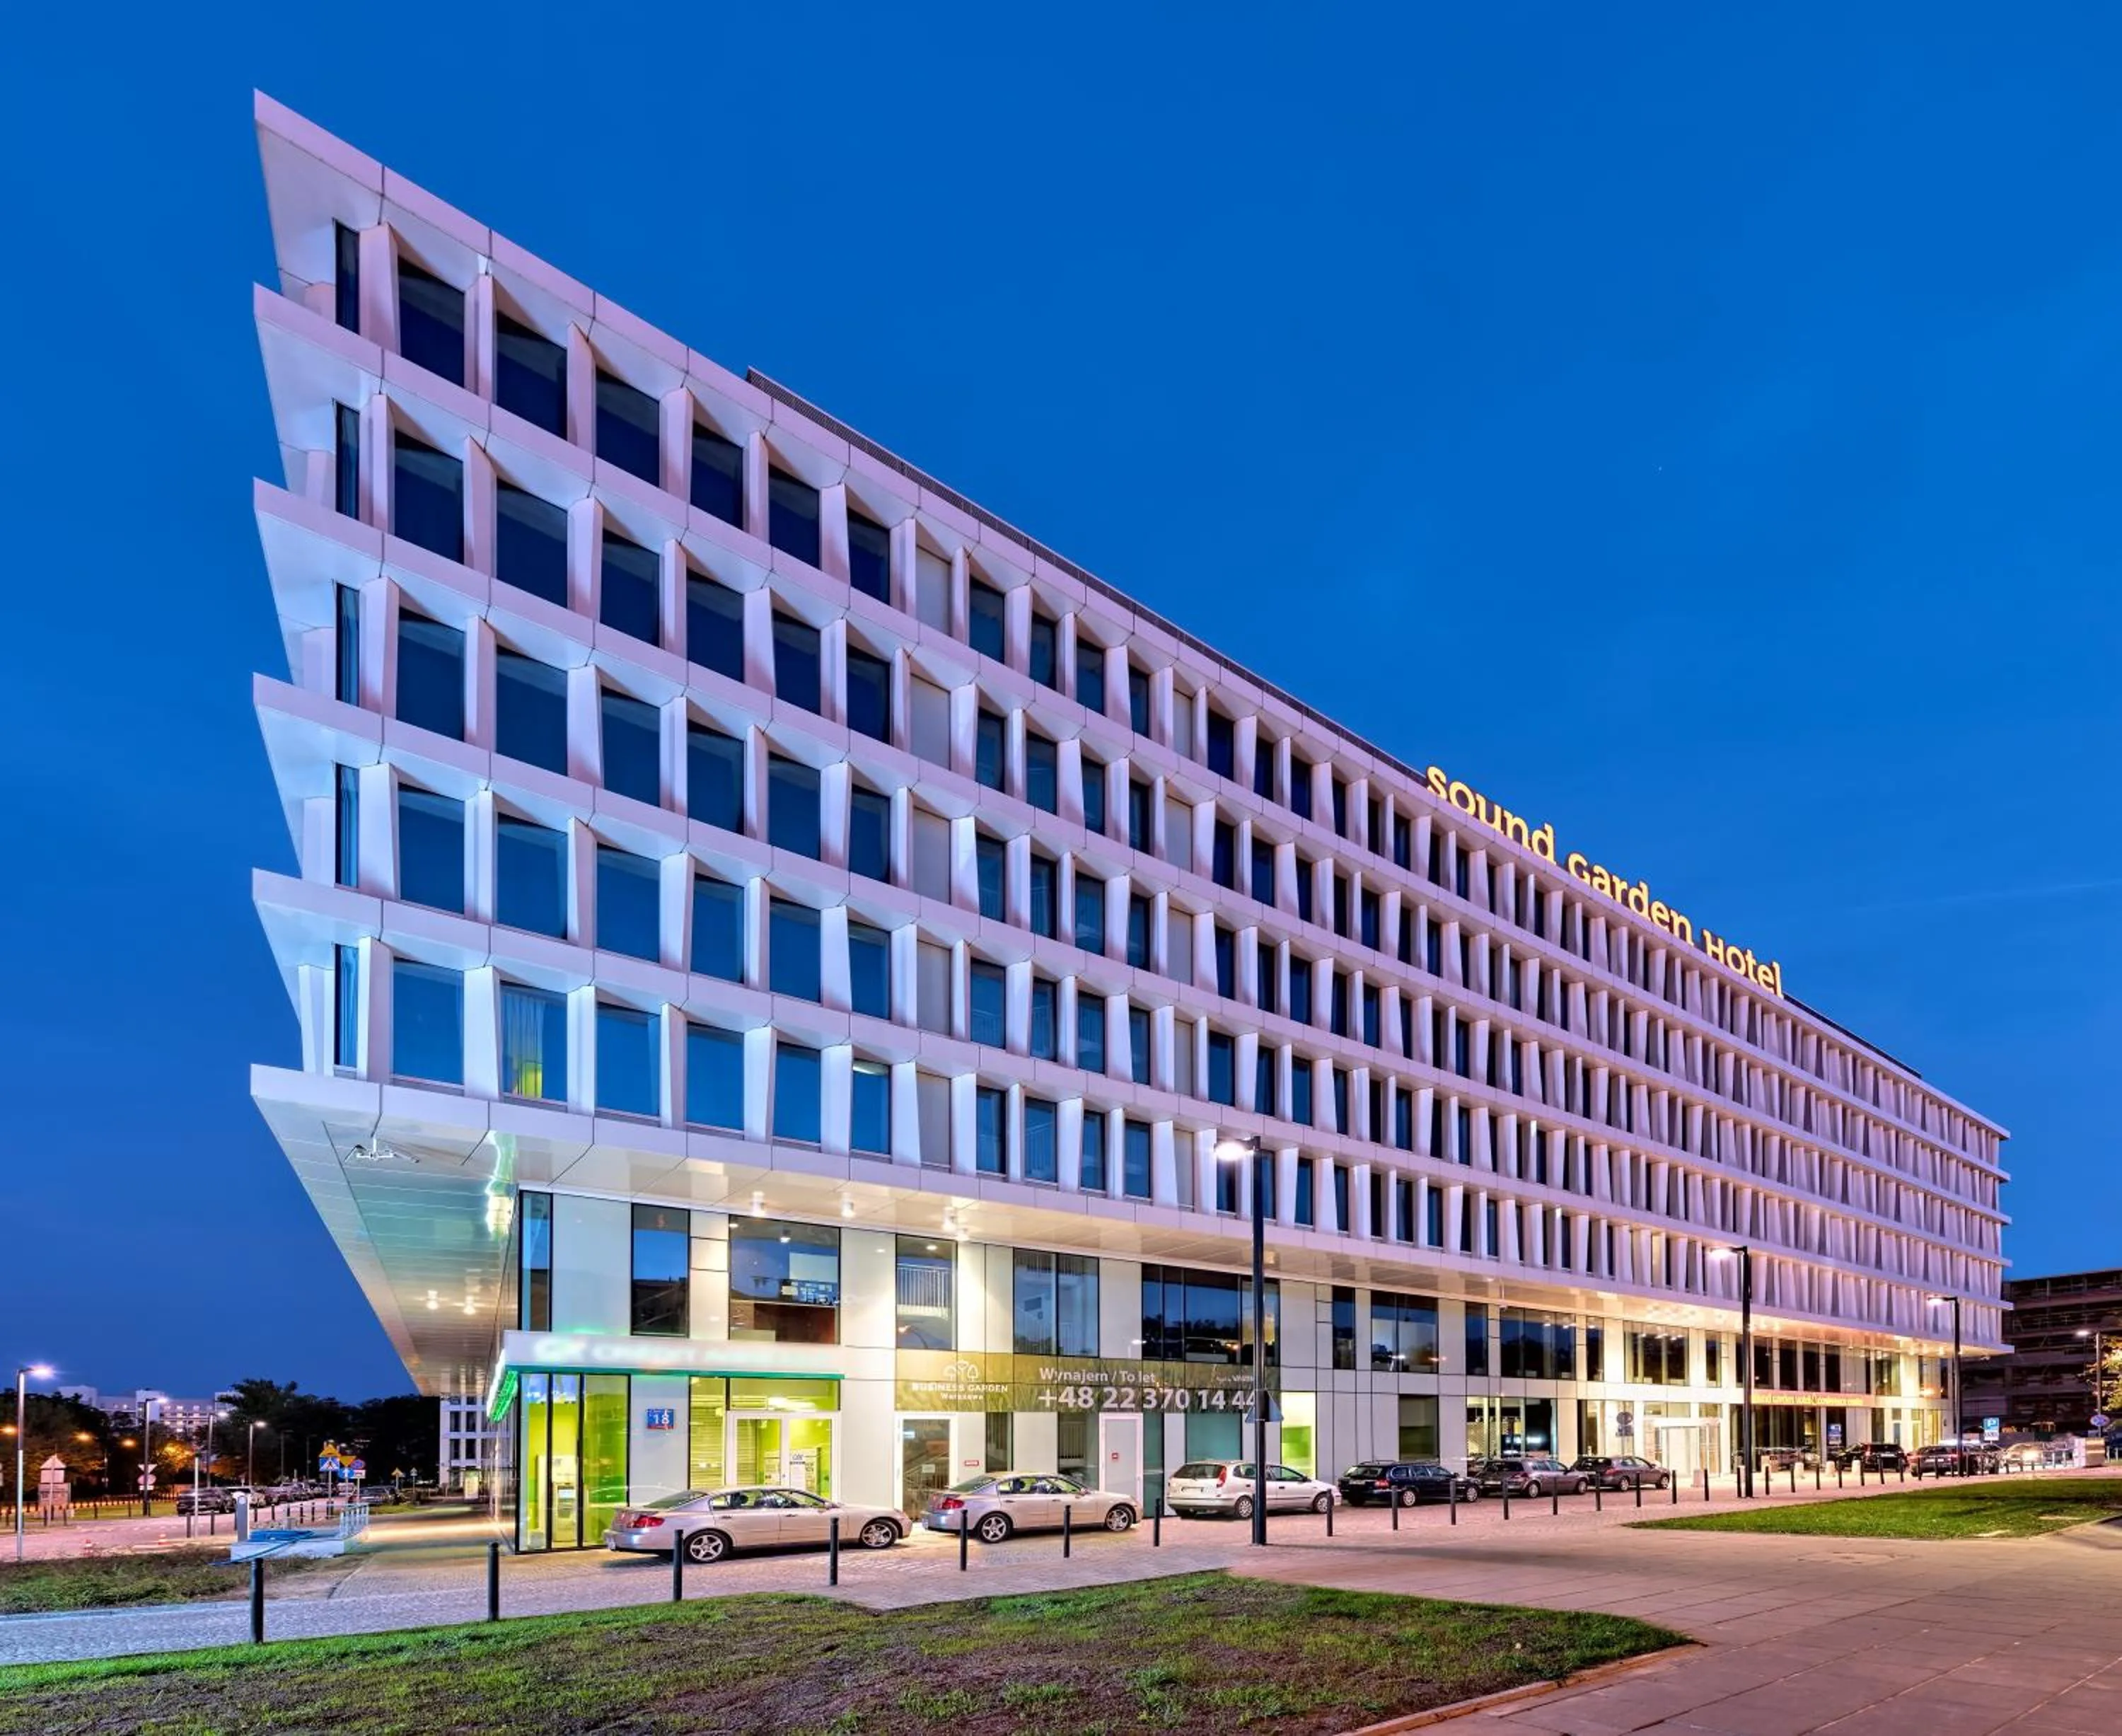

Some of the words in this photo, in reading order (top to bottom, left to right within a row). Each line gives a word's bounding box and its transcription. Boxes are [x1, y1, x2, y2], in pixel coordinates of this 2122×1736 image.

[1567, 852, 1695, 947] Garden
[1702, 927, 1785, 999] Hotel
[1039, 1367, 1108, 1384] Wynajem
[1119, 1371, 1135, 1382] To
[1137, 1371, 1156, 1383] let
[912, 1382, 965, 1392] BUSINESS
[967, 1383, 1008, 1393] GARDEN
[1038, 1386, 1094, 1408] +48
[1103, 1387, 1135, 1409] 22
[1143, 1387, 1190, 1409] 370
[1198, 1389, 1227, 1410] 14
[653, 1414, 670, 1424] 18
